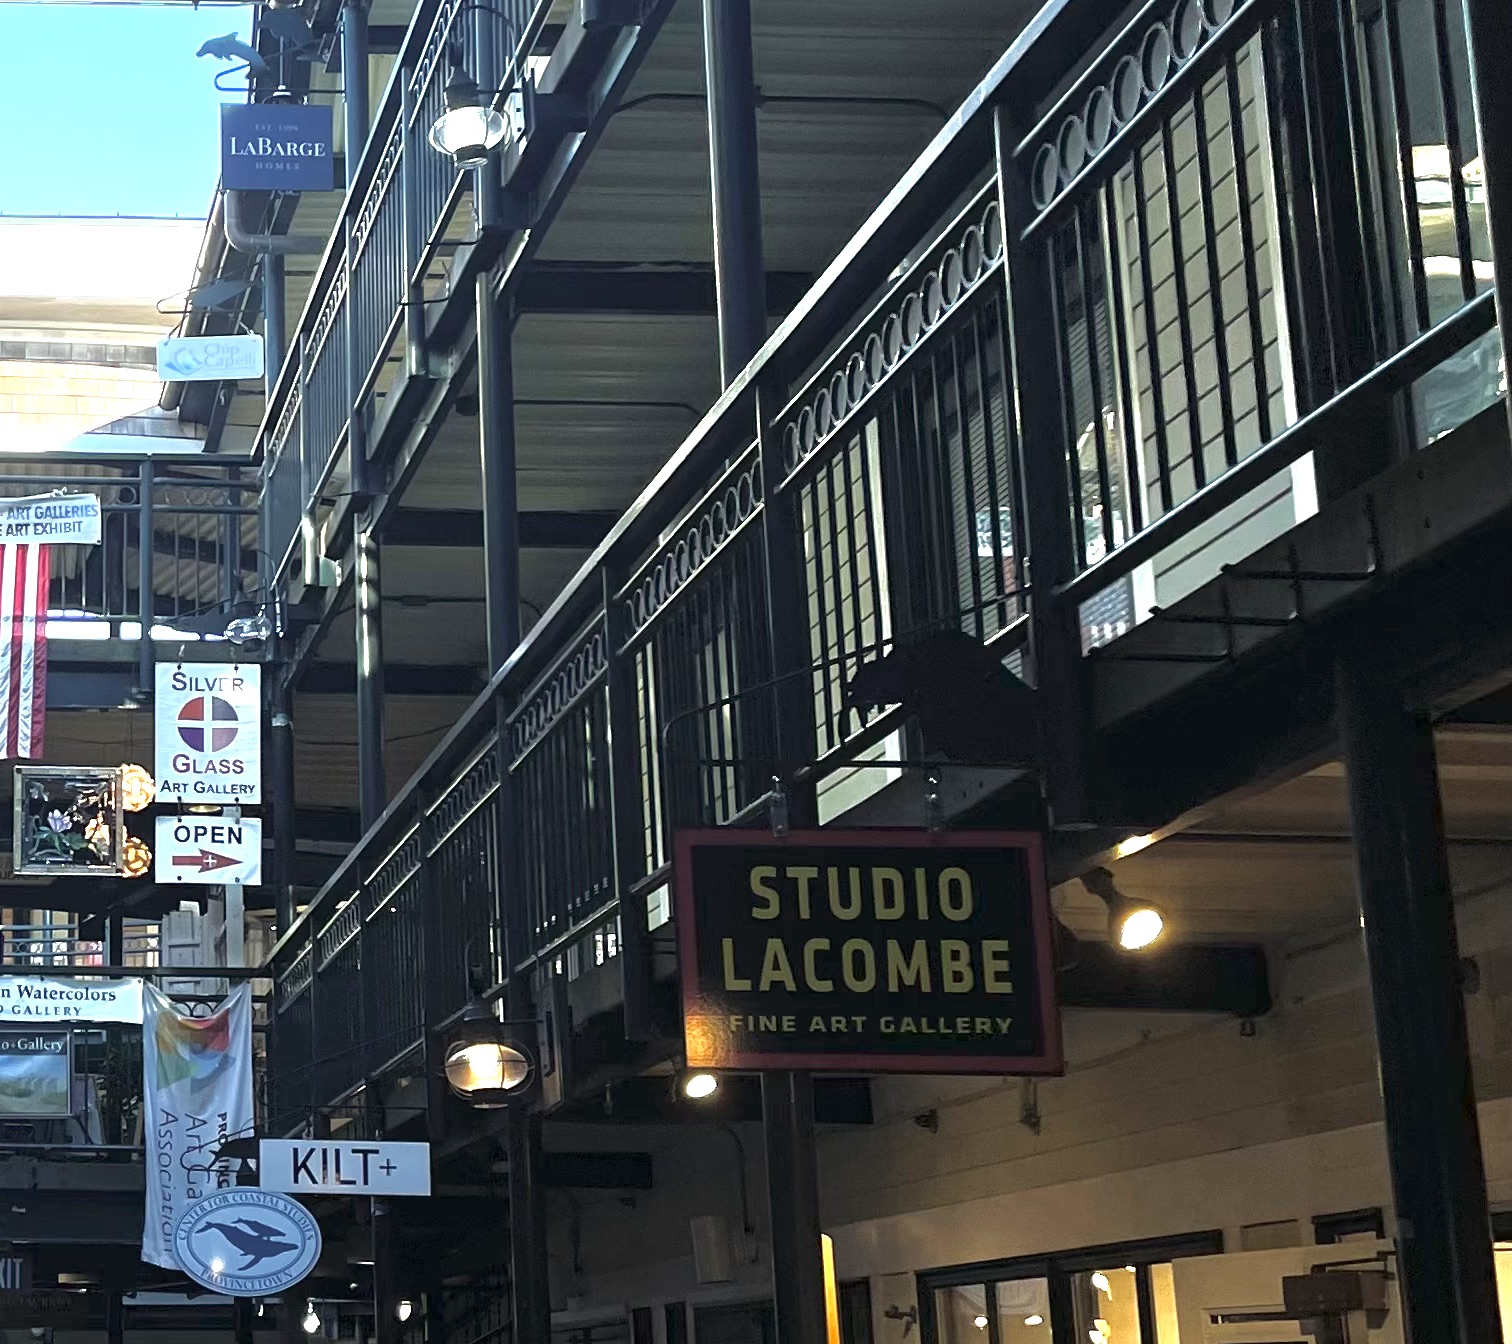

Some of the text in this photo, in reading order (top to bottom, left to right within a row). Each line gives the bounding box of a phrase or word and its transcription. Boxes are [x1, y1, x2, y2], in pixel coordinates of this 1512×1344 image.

[255, 162, 300, 170] HOMES
[204, 342, 240, 358] Chip
[6, 506, 31, 521] ART
[34, 504, 99, 520] GALLERIES
[5, 523, 31, 537] ART
[33, 520, 83, 536] EXHIBIT
[172, 753, 245, 775] GLASS
[174, 825, 243, 845] OPEN
[749, 865, 973, 921] STUDIO
[721, 937, 1014, 994] LACOMBE
[17, 985, 117, 1002] Watercolors
[12, 1005, 82, 1016] GALLERY
[729, 1015, 1013, 1035] FINE ART GALLERY
[17, 1036, 65, 1053] Gallery
[178, 1191, 316, 1242] CENTER FOR COASTAL STUDIES
[200, 1269, 294, 1290] PROVINCETOWN
